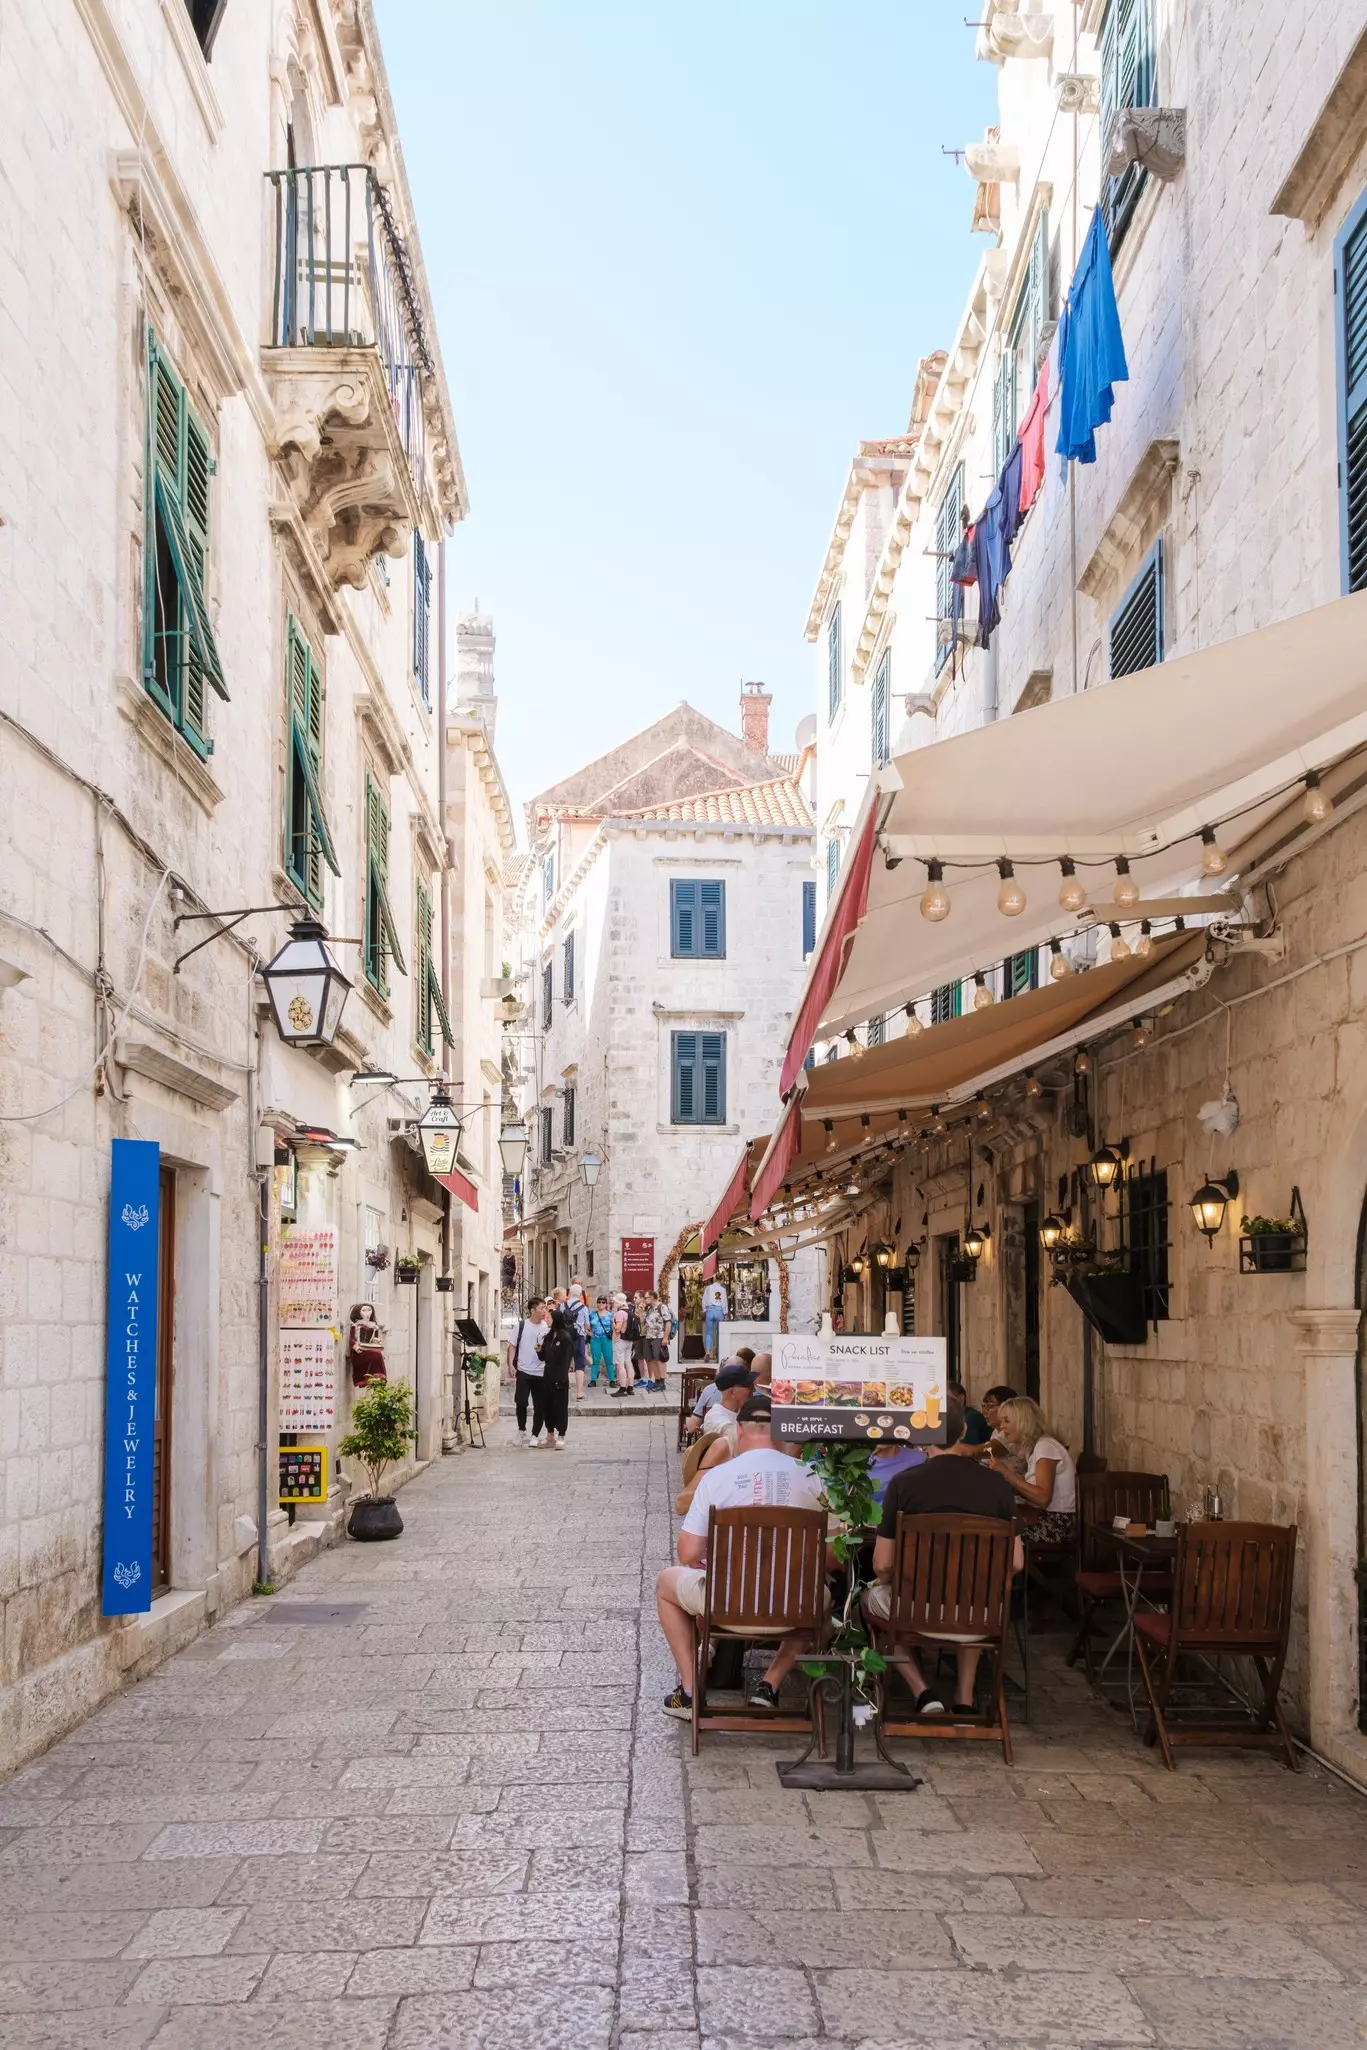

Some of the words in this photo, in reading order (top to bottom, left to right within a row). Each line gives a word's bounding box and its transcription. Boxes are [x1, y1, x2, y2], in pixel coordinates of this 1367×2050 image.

[829, 1344, 868, 1356] SNACK
[869, 1346, 891, 1356] LIST
[780, 1422, 844, 1435] BREAKFAST
